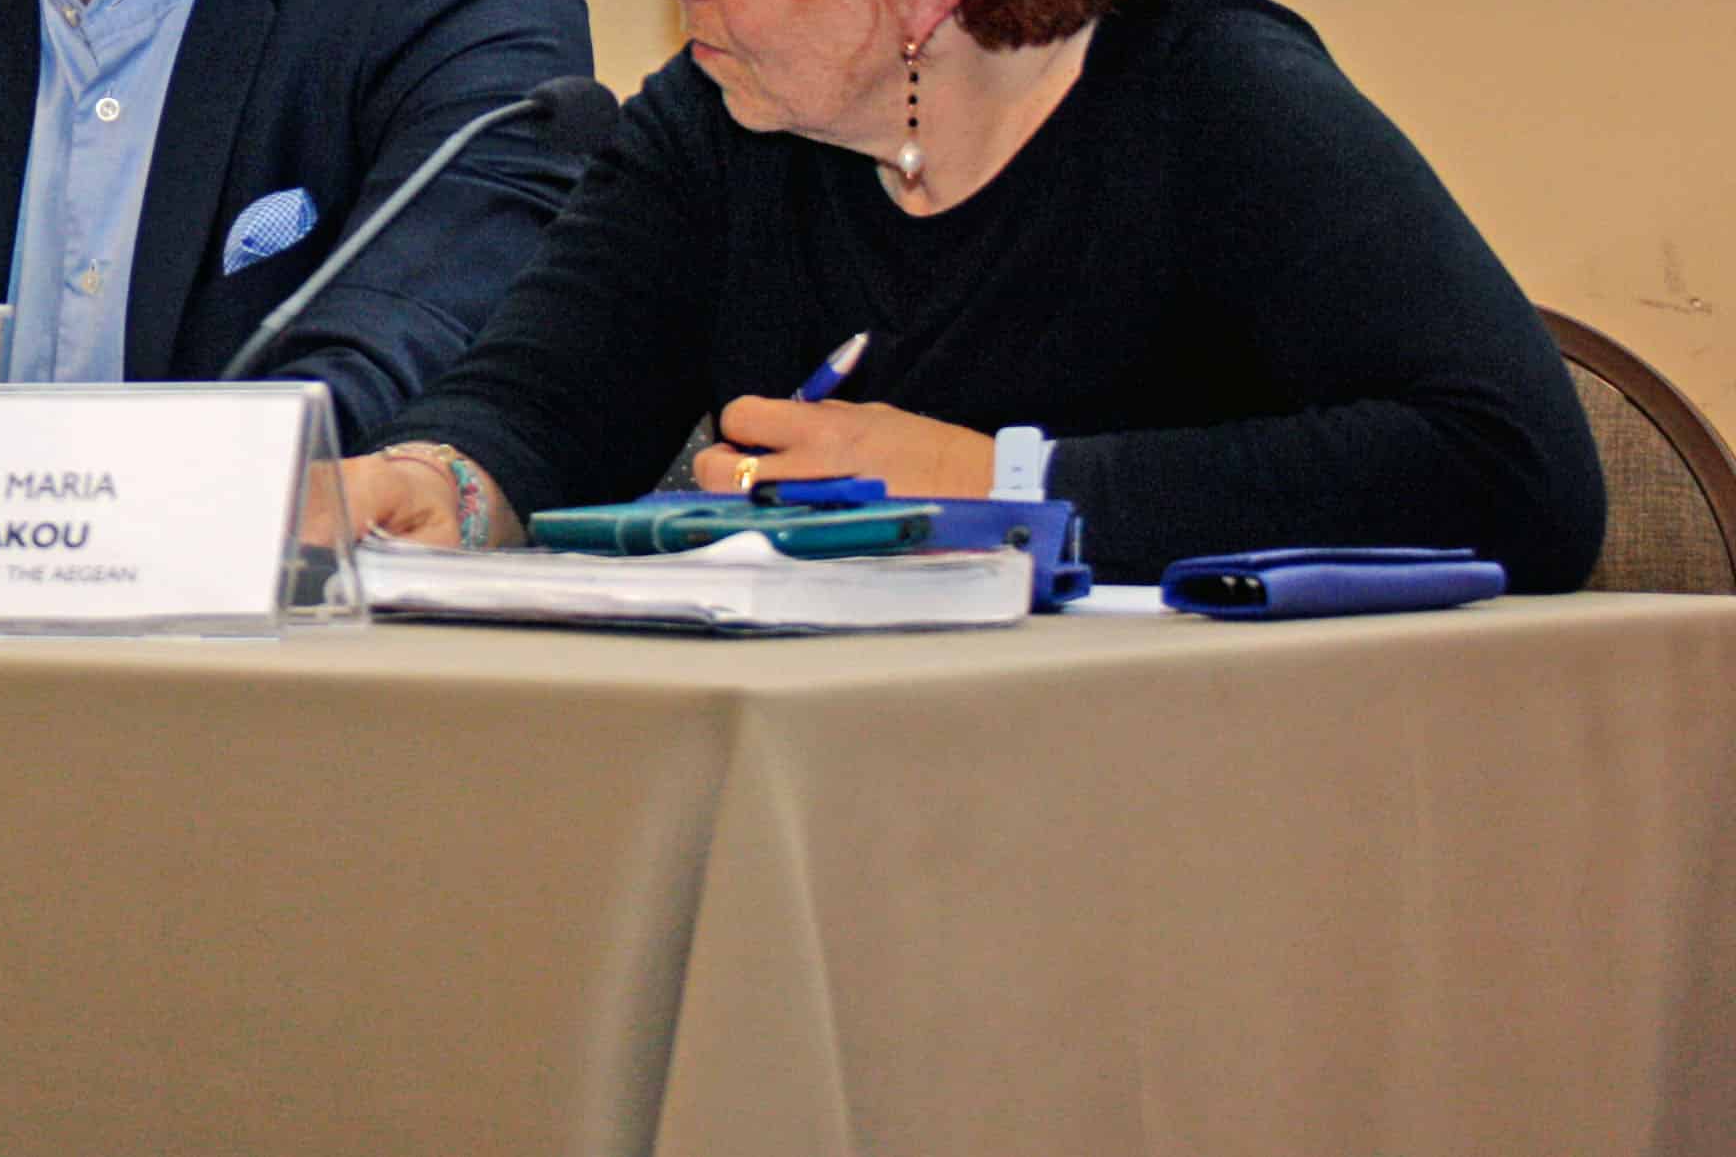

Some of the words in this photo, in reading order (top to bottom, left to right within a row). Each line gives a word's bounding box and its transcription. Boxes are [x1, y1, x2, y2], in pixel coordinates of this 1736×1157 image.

[6, 471, 116, 500] MARIA
[7, 563, 44, 582] THE
[52, 563, 139, 583] AEGEAN
